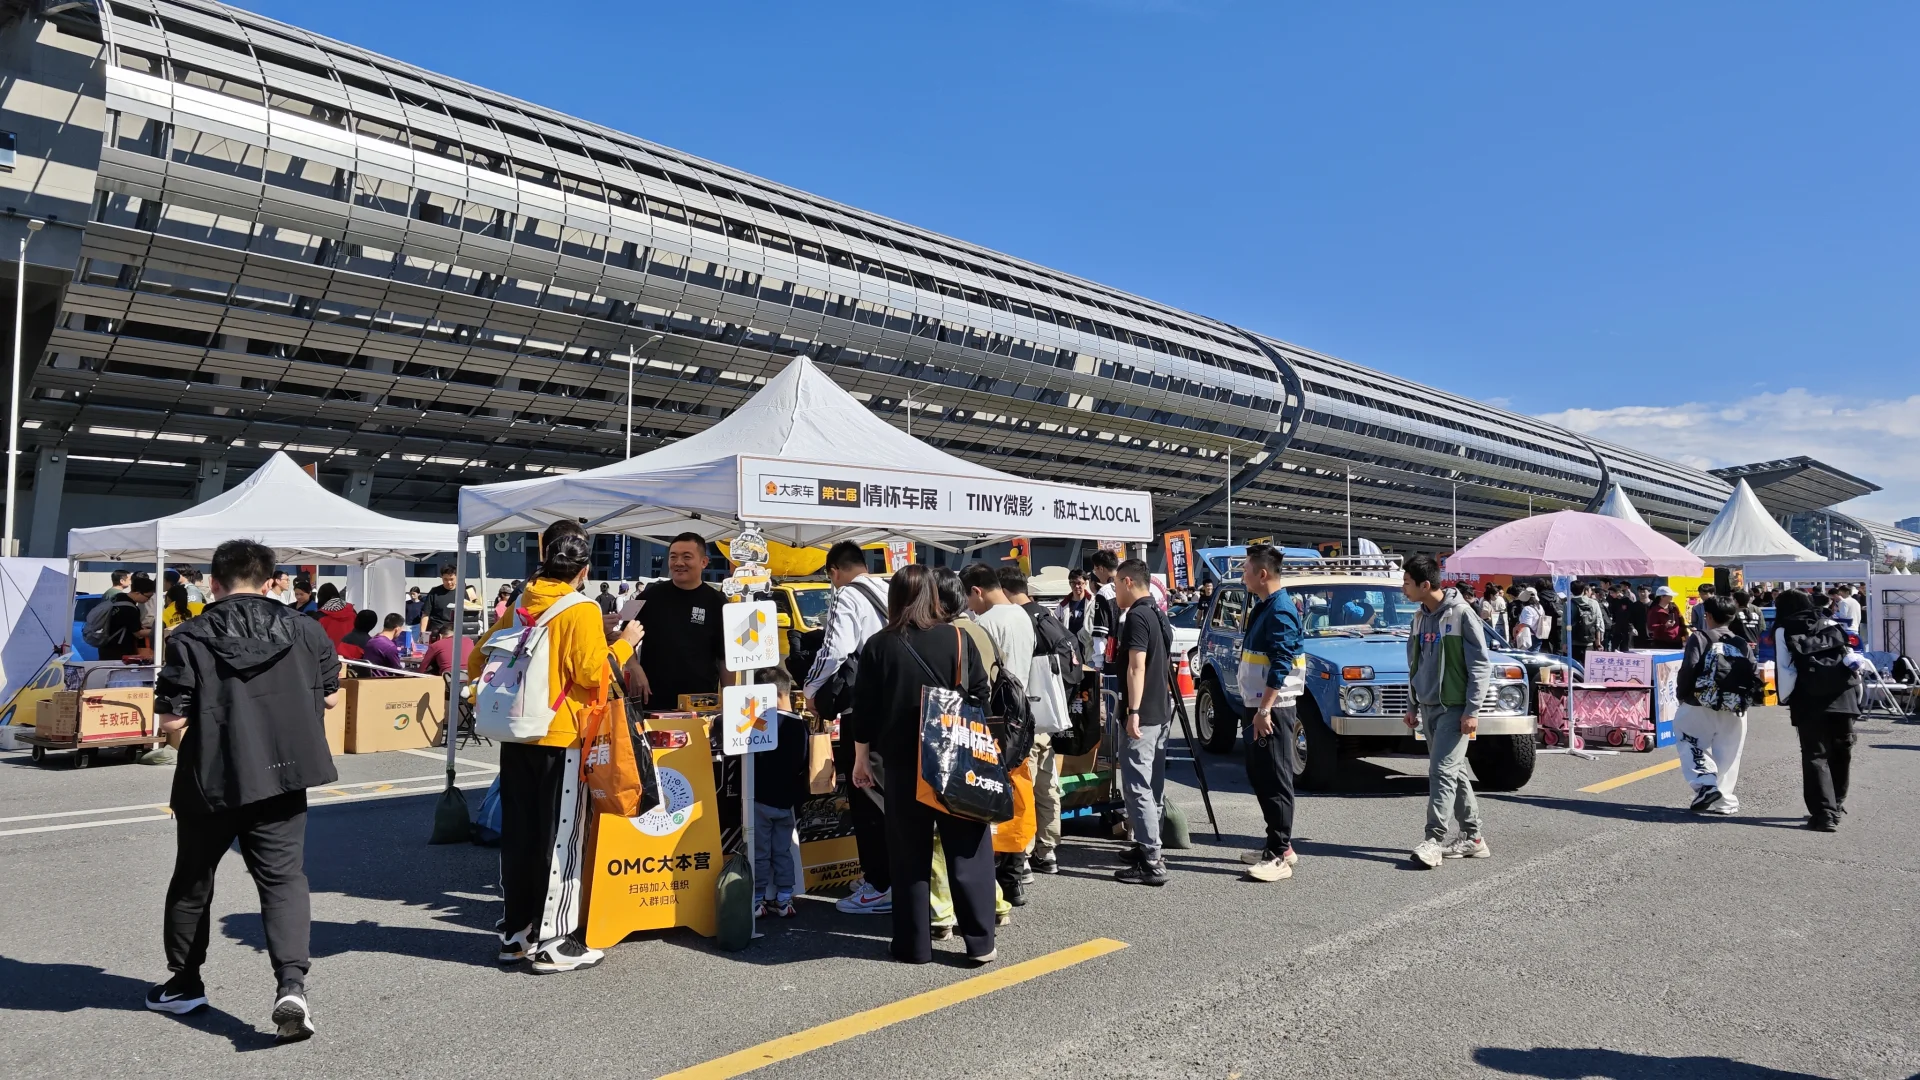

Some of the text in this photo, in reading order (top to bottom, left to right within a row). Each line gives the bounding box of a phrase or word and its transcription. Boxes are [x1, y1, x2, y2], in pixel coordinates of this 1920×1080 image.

[778, 483, 1141, 523] 大家车 第七届 情怀车展 TINY微影 极本土XLOCAL
[732, 653, 763, 664] TINY
[99, 711, 139, 728] 车致玩具
[732, 734, 773, 748] XLOCAL
[976, 775, 1004, 794] 大家车
[607, 851, 711, 876] OMC大本营
[810, 864, 837, 874] GUANG
[821, 868, 861, 881] MACHI
[628, 880, 690, 895] 扫码加入组织
[638, 894, 680, 908] 入群归队
